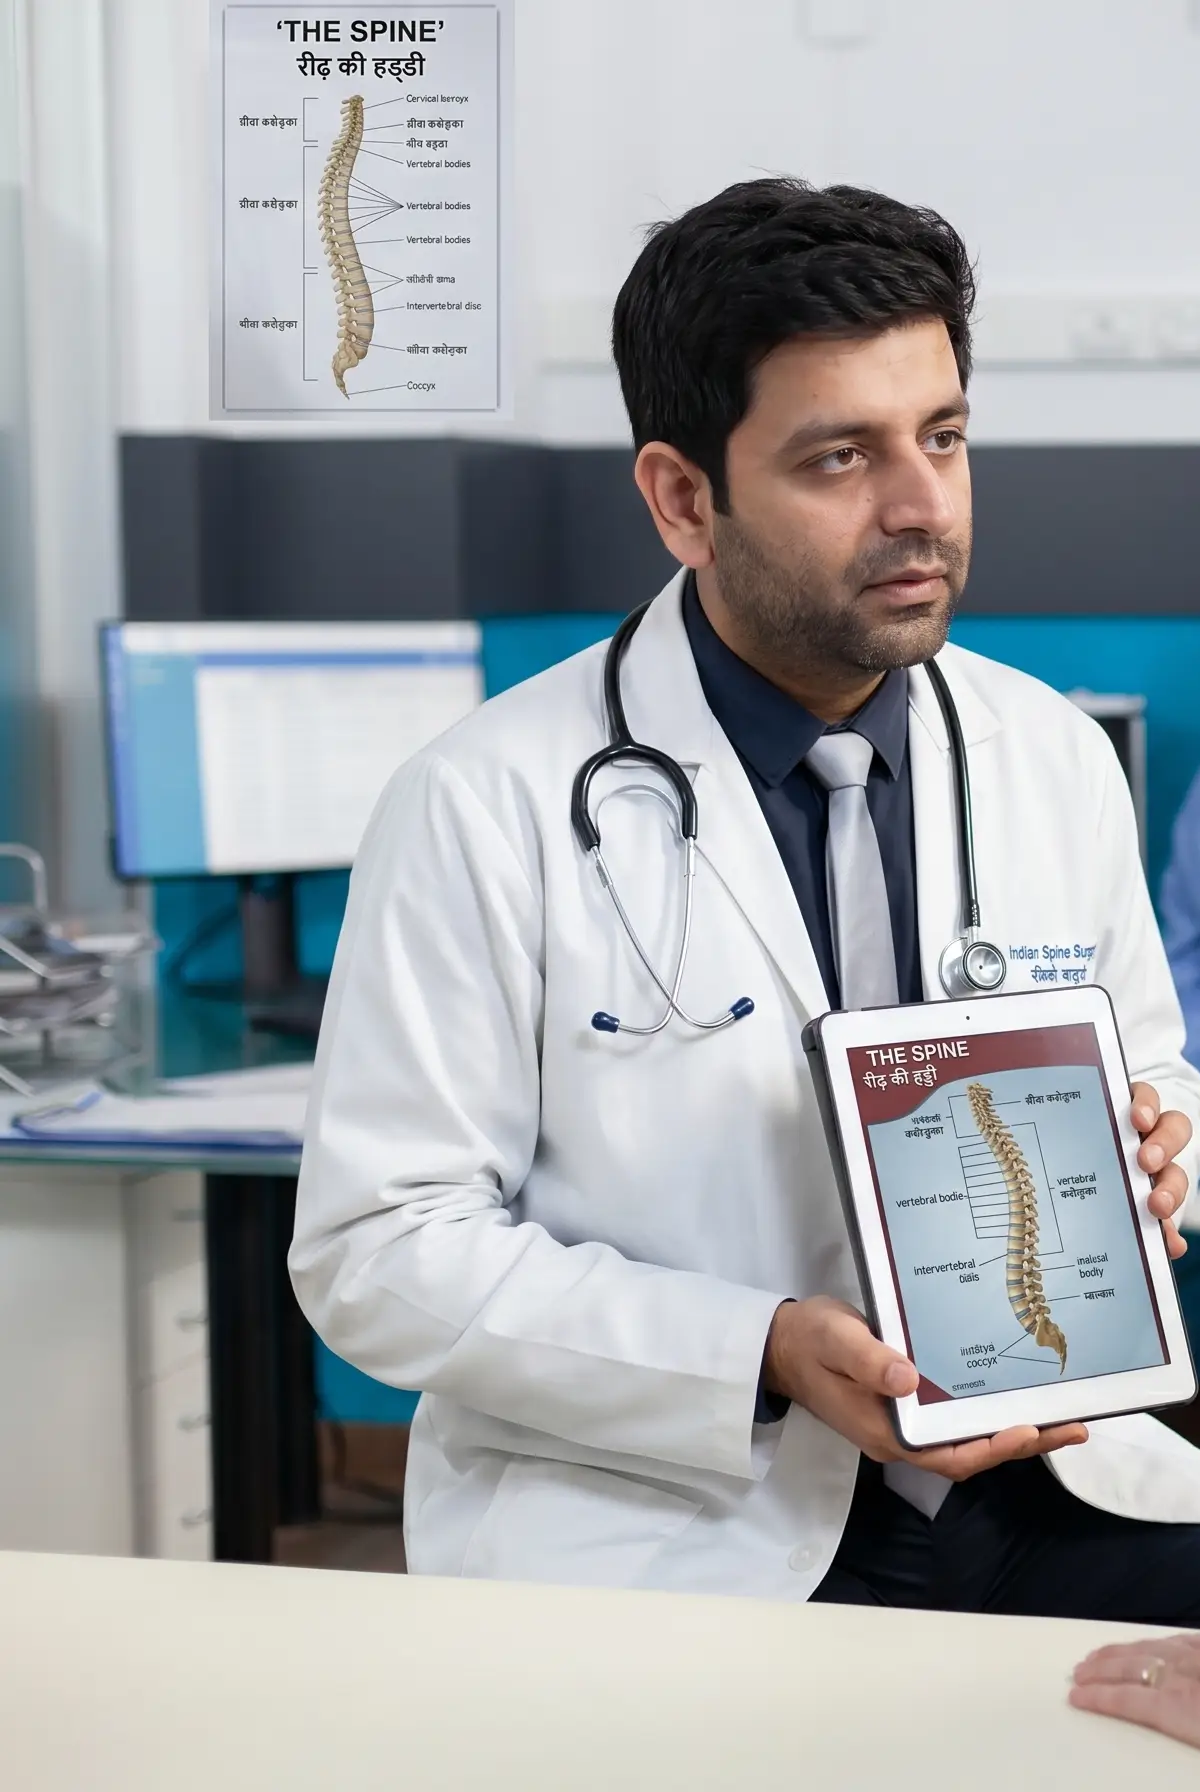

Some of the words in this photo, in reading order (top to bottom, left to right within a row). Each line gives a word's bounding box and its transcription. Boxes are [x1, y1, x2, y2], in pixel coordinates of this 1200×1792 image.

[296, 51, 332, 81] रीढ़
[337, 51, 367, 76] की
[406, 94, 438, 103] Cervical
[406, 159, 442, 169] Vertebral
[444, 159, 471, 169] bodies
[406, 202, 442, 211] Vertebral
[444, 202, 471, 211] bodies
[406, 236, 442, 245] Vertebral
[444, 236, 471, 245] bodies
[406, 301, 462, 310] Intervertebral
[464, 301, 482, 310] disc
[406, 381, 436, 392] Coccyx
[1009, 945, 1039, 960] Indian
[1042, 945, 1071, 962] Spine
[865, 1047, 908, 1067] THE
[911, 1040, 970, 1062] SPINE
[863, 1071, 888, 1091] रीढ़
[889, 1067, 909, 1085] की
[896, 1194, 938, 1208] vertebral
[913, 1258, 976, 1276] intervertebral
[966, 1356, 998, 1369] coccyx
